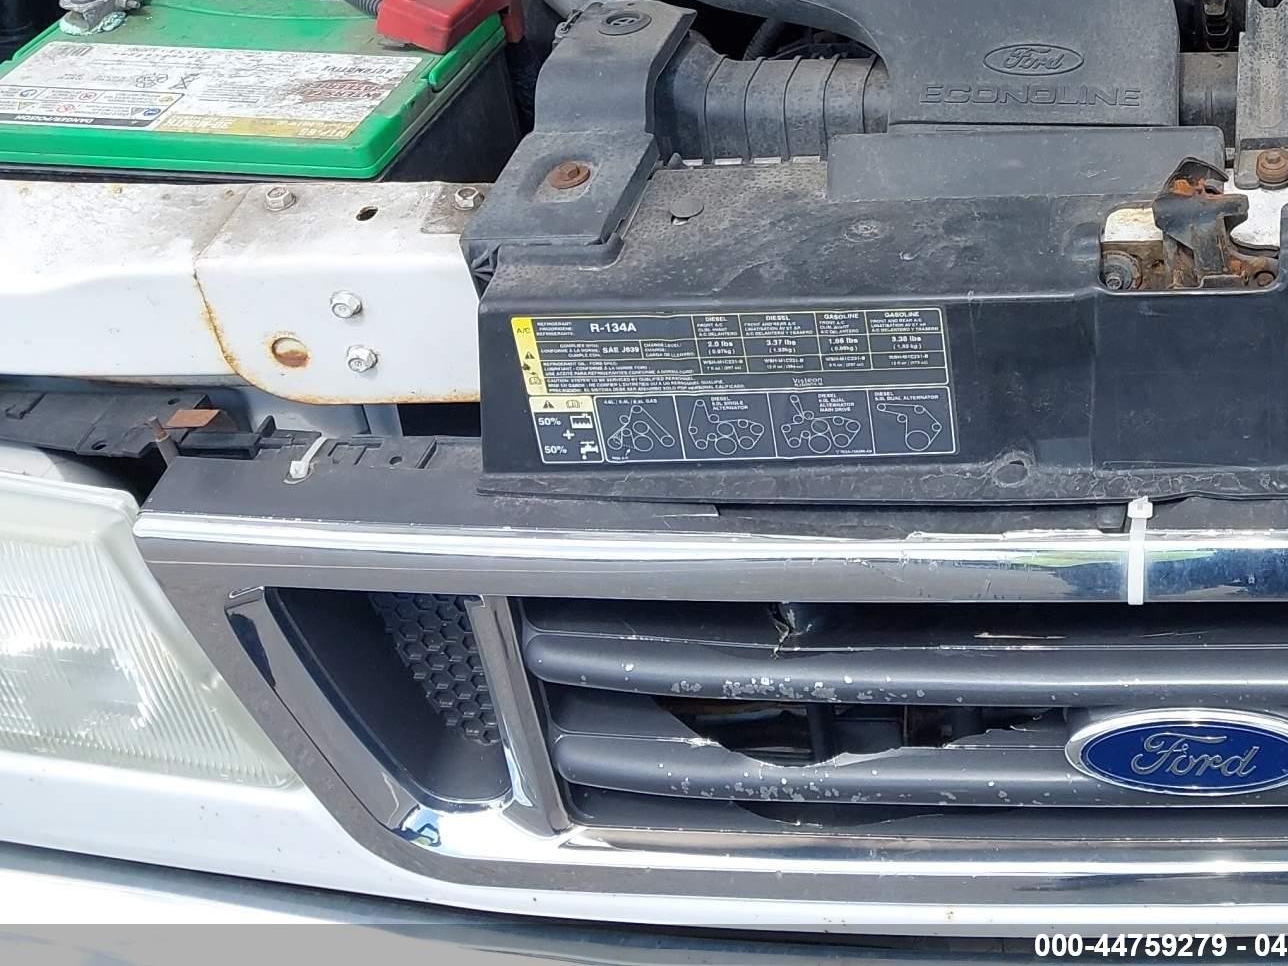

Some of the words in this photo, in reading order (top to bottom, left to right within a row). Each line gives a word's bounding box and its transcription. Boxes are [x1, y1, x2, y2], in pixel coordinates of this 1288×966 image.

[1002, 47, 1065, 70] Ford
[919, 84, 1141, 106] ECONOLINE
[589, 322, 637, 333] R-134A
[538, 417, 562, 426] 50%
[544, 445, 568, 454] 50%
[1131, 732, 1259, 777] Ford
